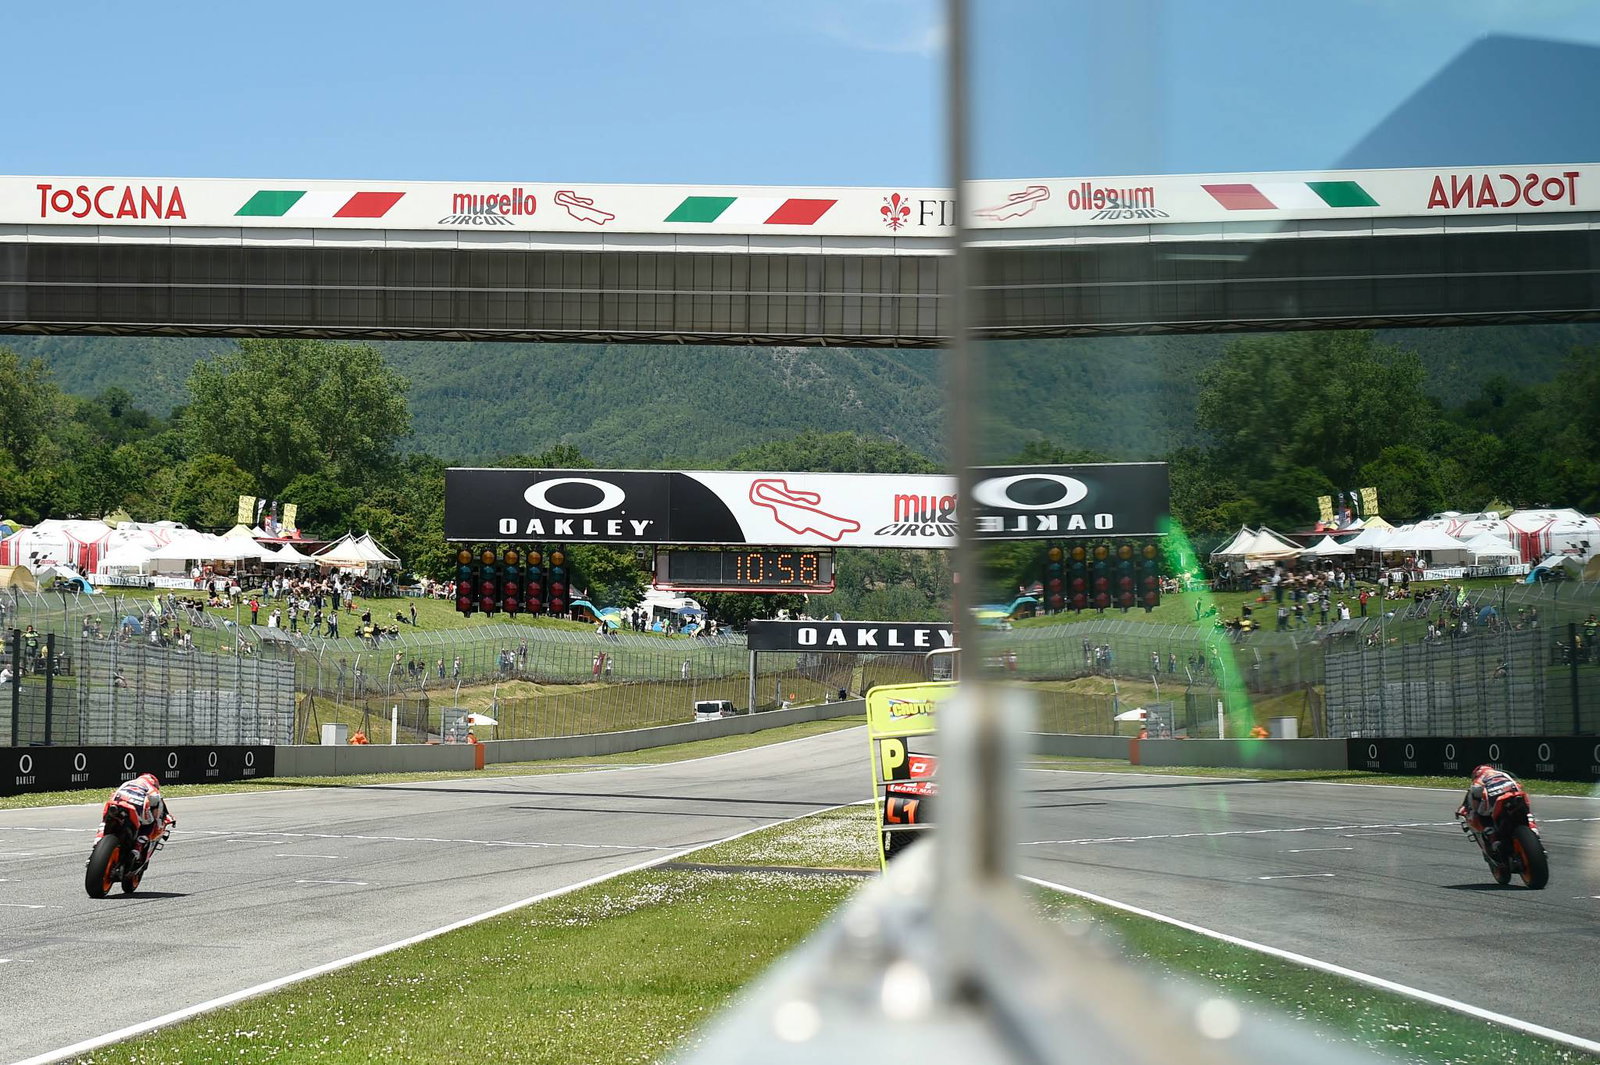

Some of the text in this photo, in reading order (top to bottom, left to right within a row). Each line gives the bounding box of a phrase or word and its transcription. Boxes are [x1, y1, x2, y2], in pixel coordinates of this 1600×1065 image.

[452, 188, 537, 215] mugello
[437, 215, 515, 225] CIRCUIT
[499, 518, 650, 536] OAKLEY
[737, 553, 817, 584] 10:58
[797, 627, 954, 647] OAKLEY
[880, 738, 905, 780] P
[16, 775, 36, 785] OAKLEY
[71, 773, 89, 782] OAKLEY
[887, 797, 919, 824] L1
